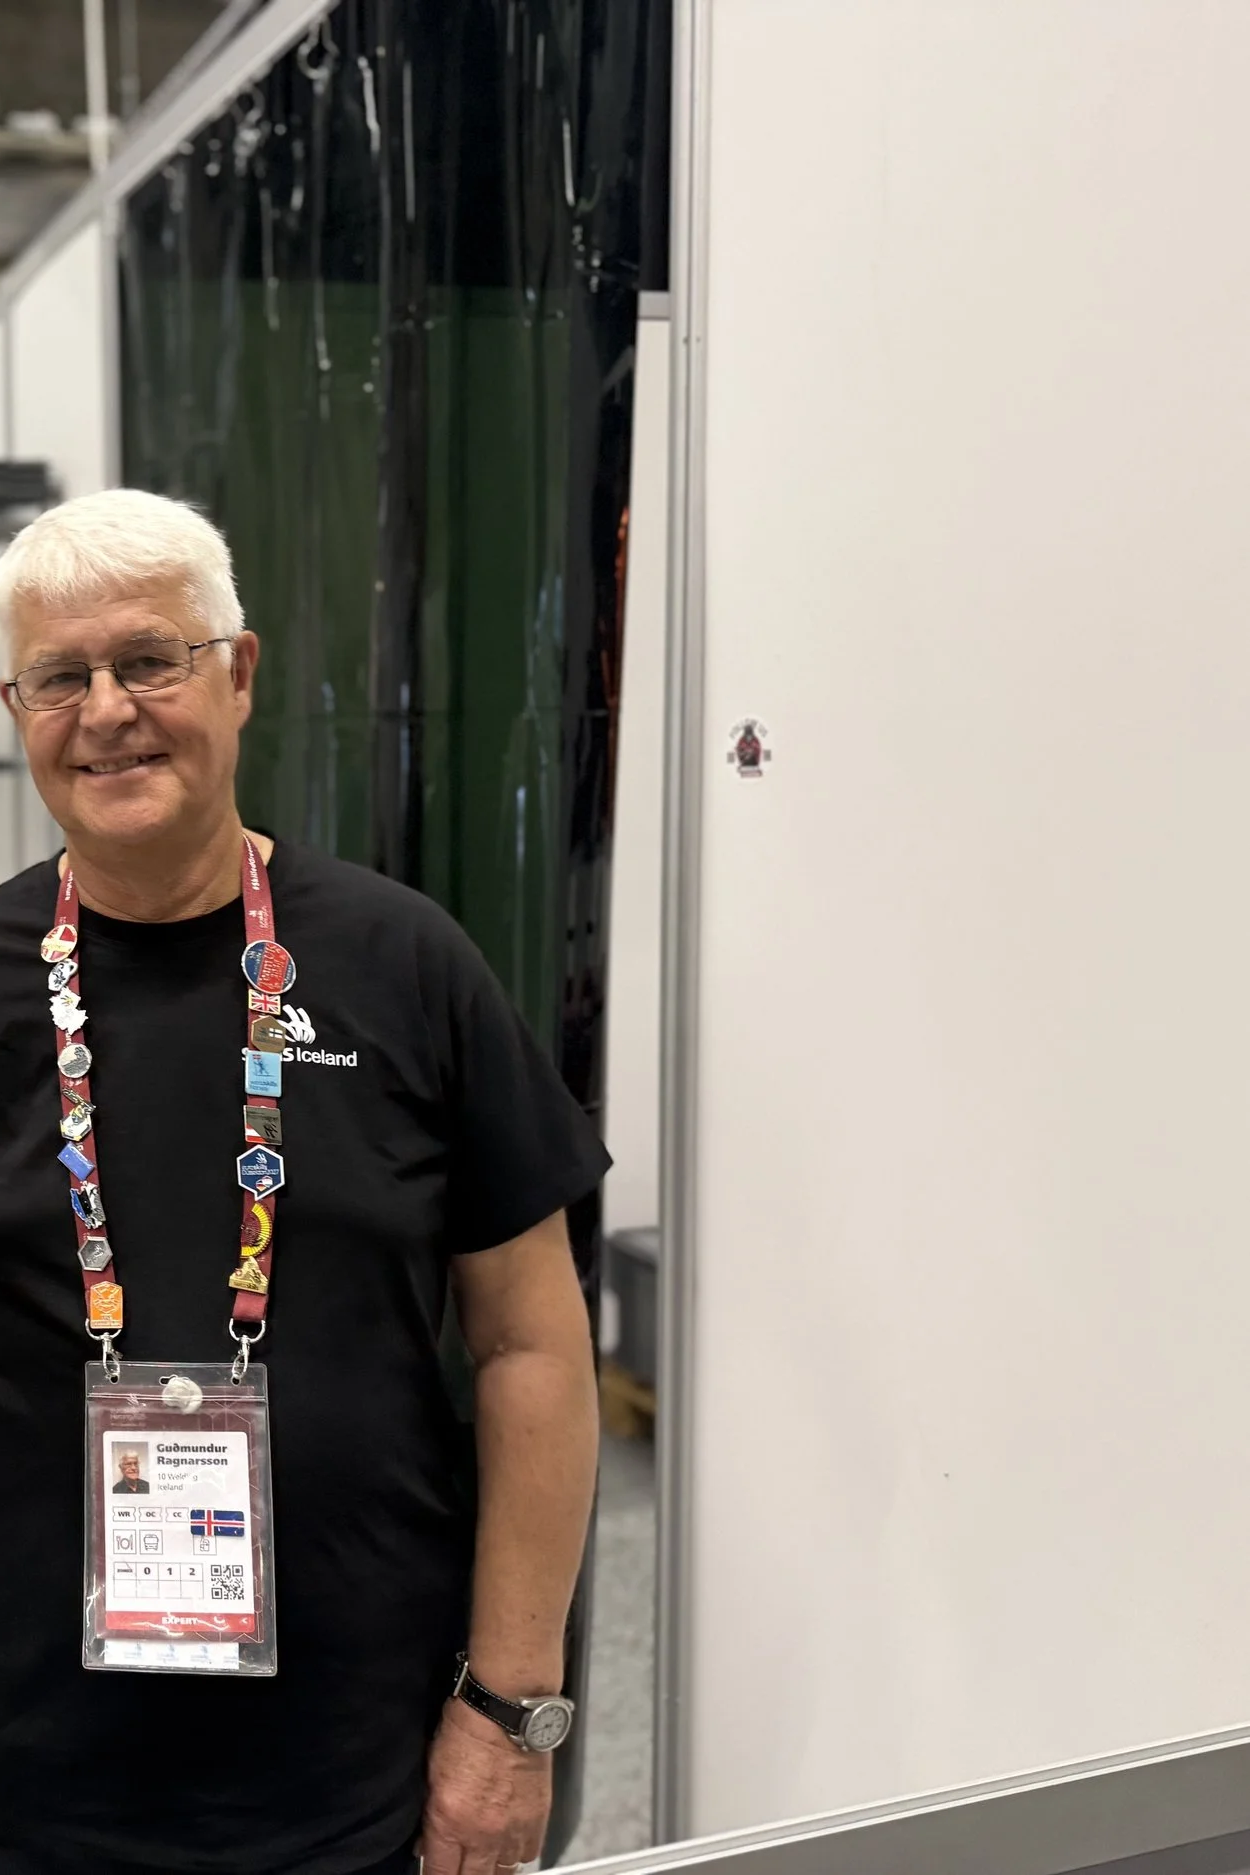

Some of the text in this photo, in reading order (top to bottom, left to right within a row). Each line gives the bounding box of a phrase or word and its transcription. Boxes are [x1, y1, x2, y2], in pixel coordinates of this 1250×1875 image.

[296, 1046, 358, 1067] Iceland
[156, 1443, 228, 1453] Guðmundur
[157, 1456, 228, 1467] Ragnarsson
[157, 1483, 184, 1491] Iceland
[144, 1567, 151, 1575] 0
[166, 1567, 173, 1575] 1
[189, 1567, 196, 1576] 2
[161, 1616, 198, 1625] EXPERT
